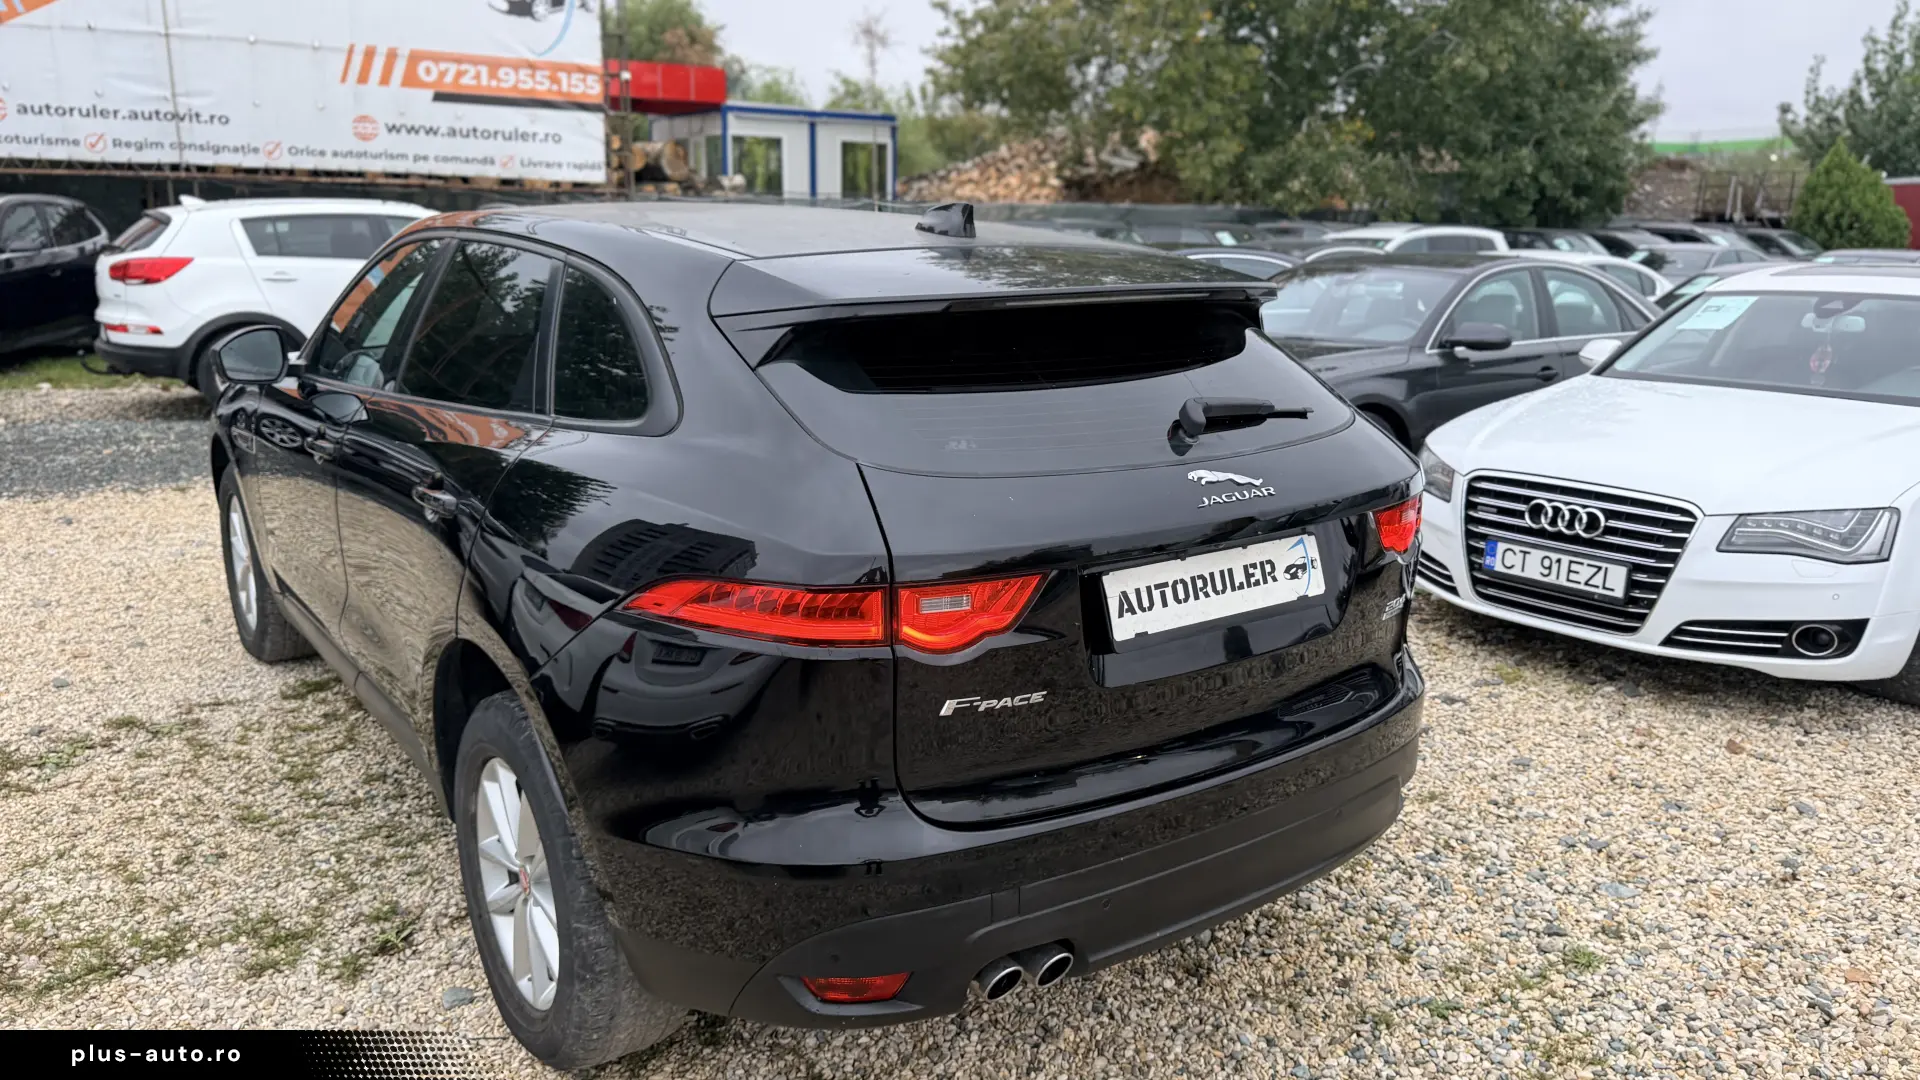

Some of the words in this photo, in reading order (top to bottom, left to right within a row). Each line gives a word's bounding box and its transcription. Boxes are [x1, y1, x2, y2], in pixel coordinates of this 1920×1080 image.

[417, 60, 601, 95] 0721.955.155
[16, 103, 230, 126] autoruler.autovit.ro
[384, 121, 563, 144] www.autoruler.ro
[112, 137, 165, 152] Regim
[288, 145, 327, 158] Orice
[331, 147, 409, 161] autoturism
[413, 153, 430, 164] pe
[519, 157, 565, 170] Livrare
[1198, 486, 1276, 508] JAGUAR
[1501, 547, 1532, 573] CT
[1117, 558, 1279, 619] AUTORULER
[938, 690, 1048, 717] F-PACE
